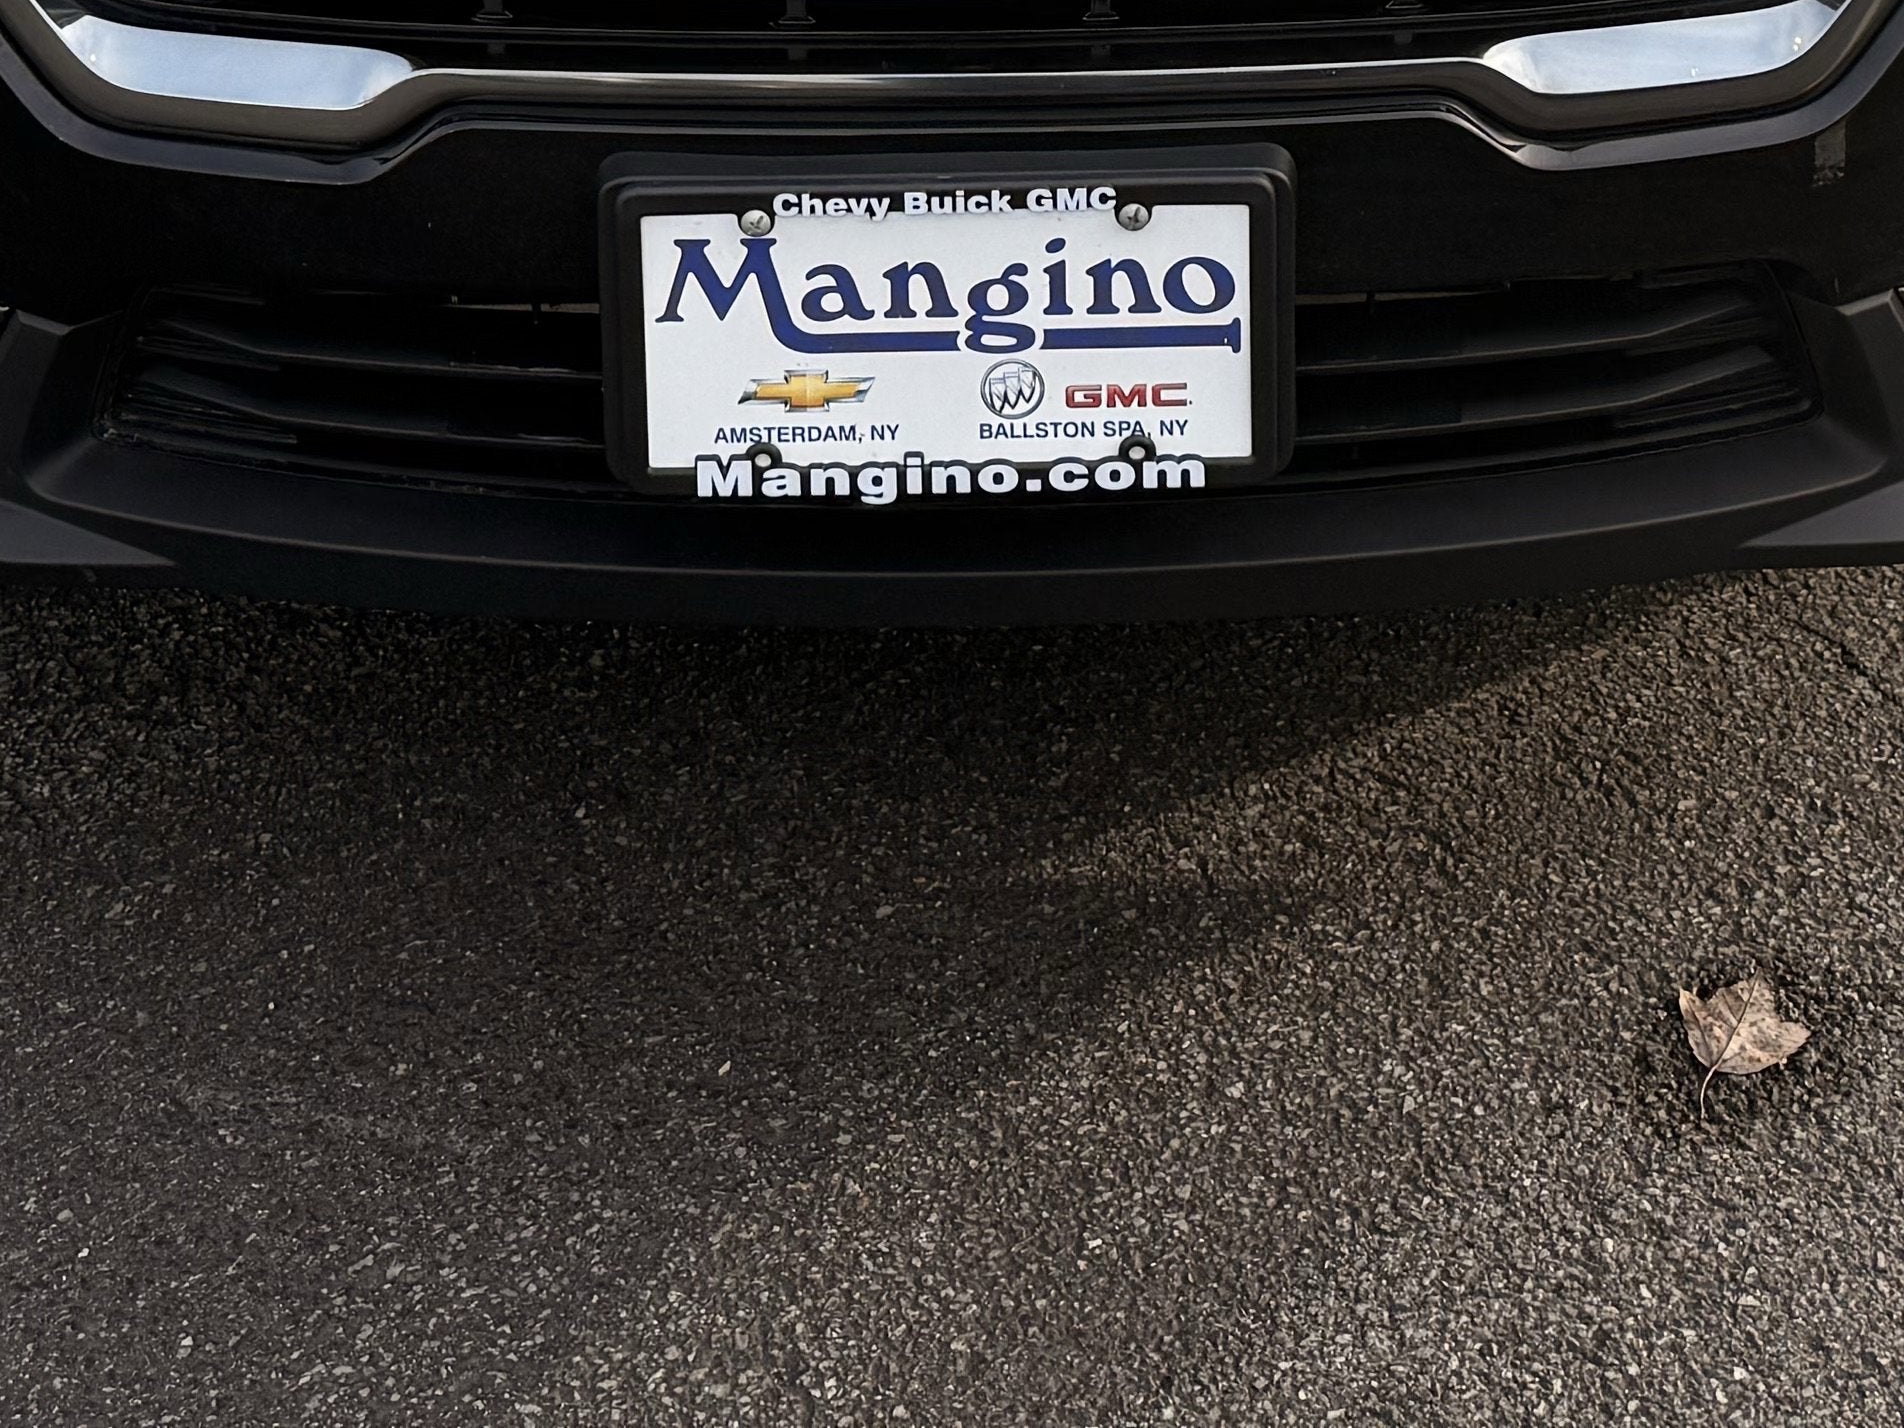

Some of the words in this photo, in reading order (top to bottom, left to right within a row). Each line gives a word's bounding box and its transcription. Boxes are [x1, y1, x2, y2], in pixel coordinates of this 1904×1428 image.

[772, 191, 891, 221] Chevy
[902, 189, 1012, 216] Buick
[1026, 186, 1118, 213] GMC
[655, 236, 1242, 354] Mangino
[1064, 382, 1189, 410] GMC
[713, 424, 865, 445] AMSTERDAM,
[869, 423, 900, 442] NY
[978, 420, 1096, 441] BALLSTON
[1103, 419, 1153, 440] SPA,
[1159, 418, 1189, 438] NY
[696, 453, 1207, 506] Mangino.com
